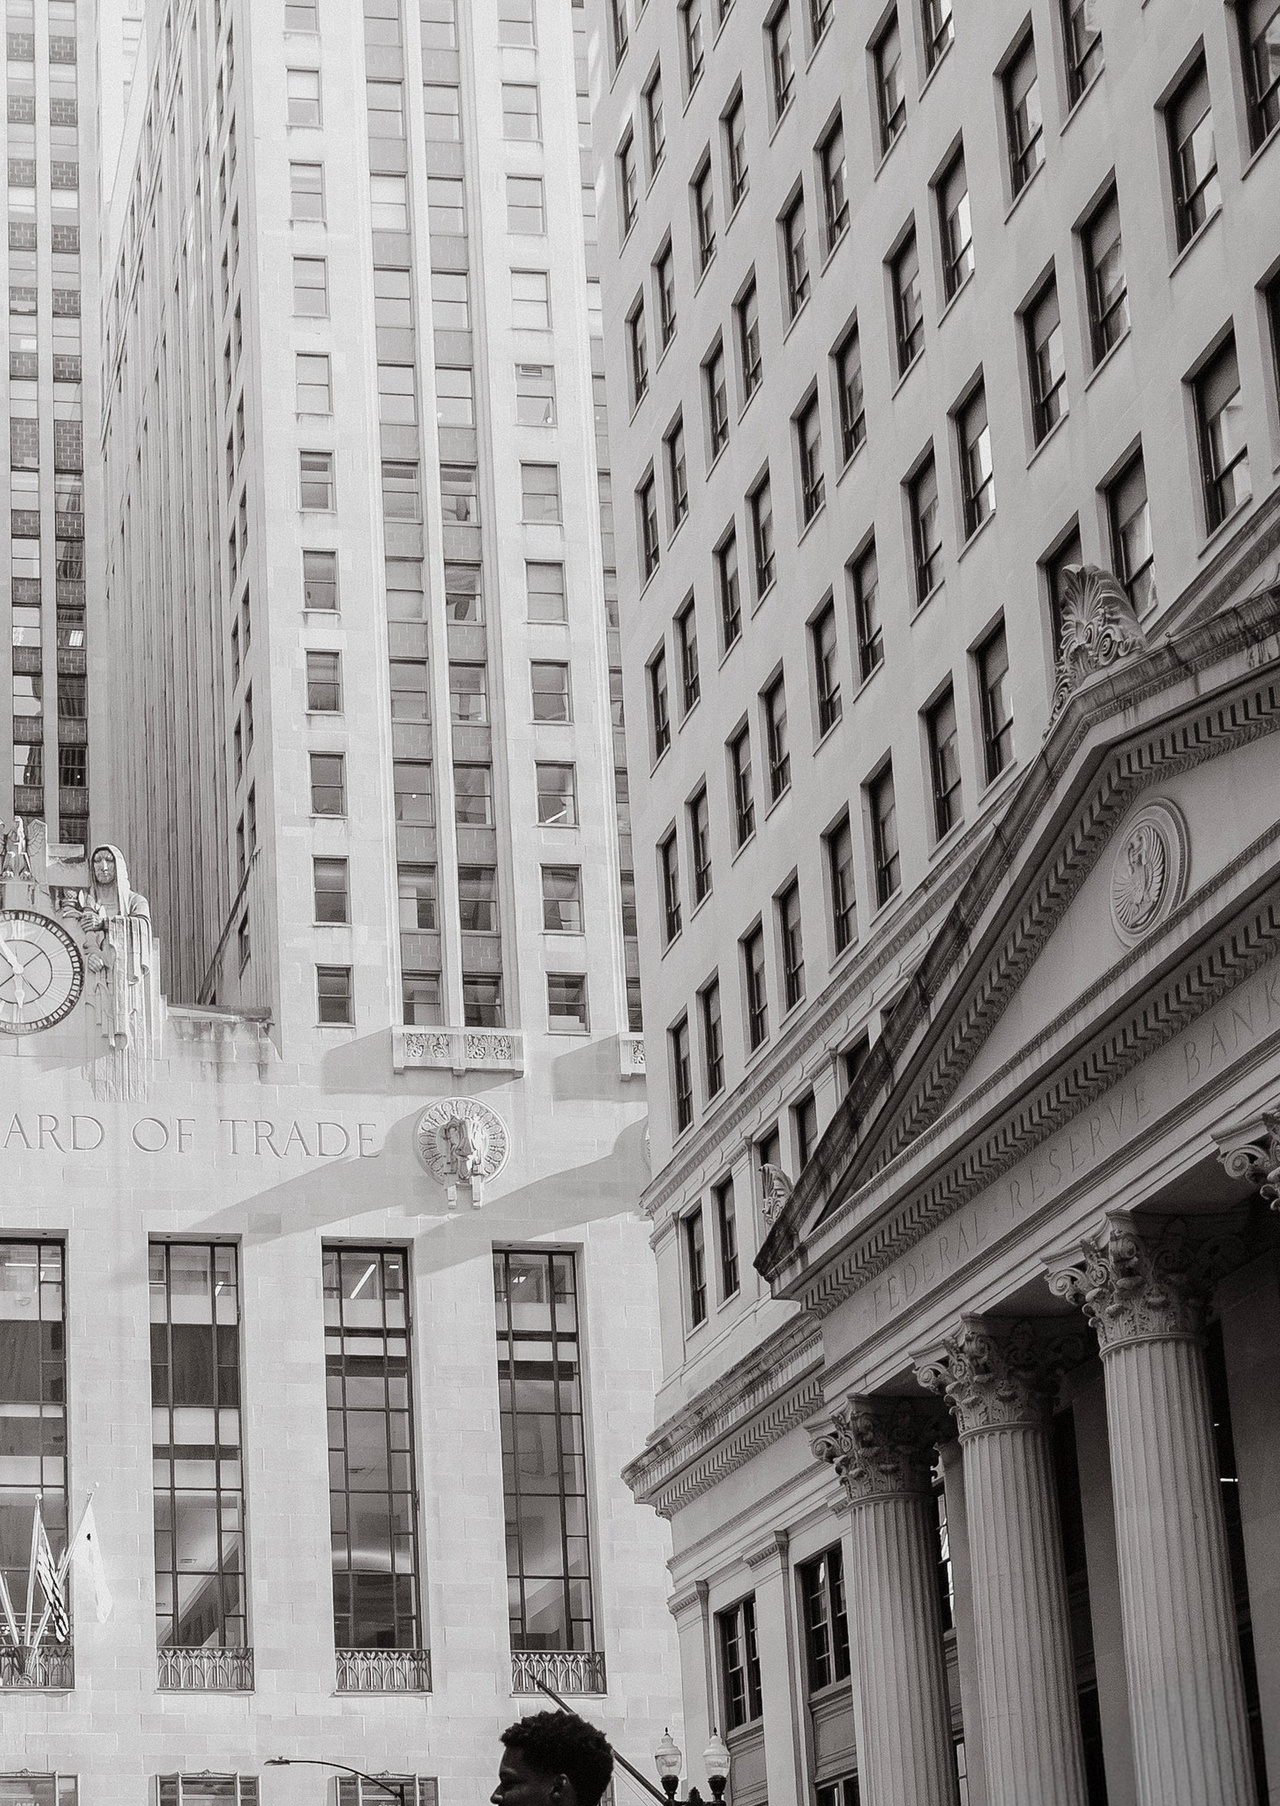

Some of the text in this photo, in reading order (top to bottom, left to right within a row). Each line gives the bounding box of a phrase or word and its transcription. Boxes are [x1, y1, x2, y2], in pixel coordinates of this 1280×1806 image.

[131, 1117, 196, 1153] OF
[219, 1118, 382, 1159] TRADE
[872, 1212, 988, 1322] FEDERAL
[1009, 1085, 1151, 1218] RESERVE
